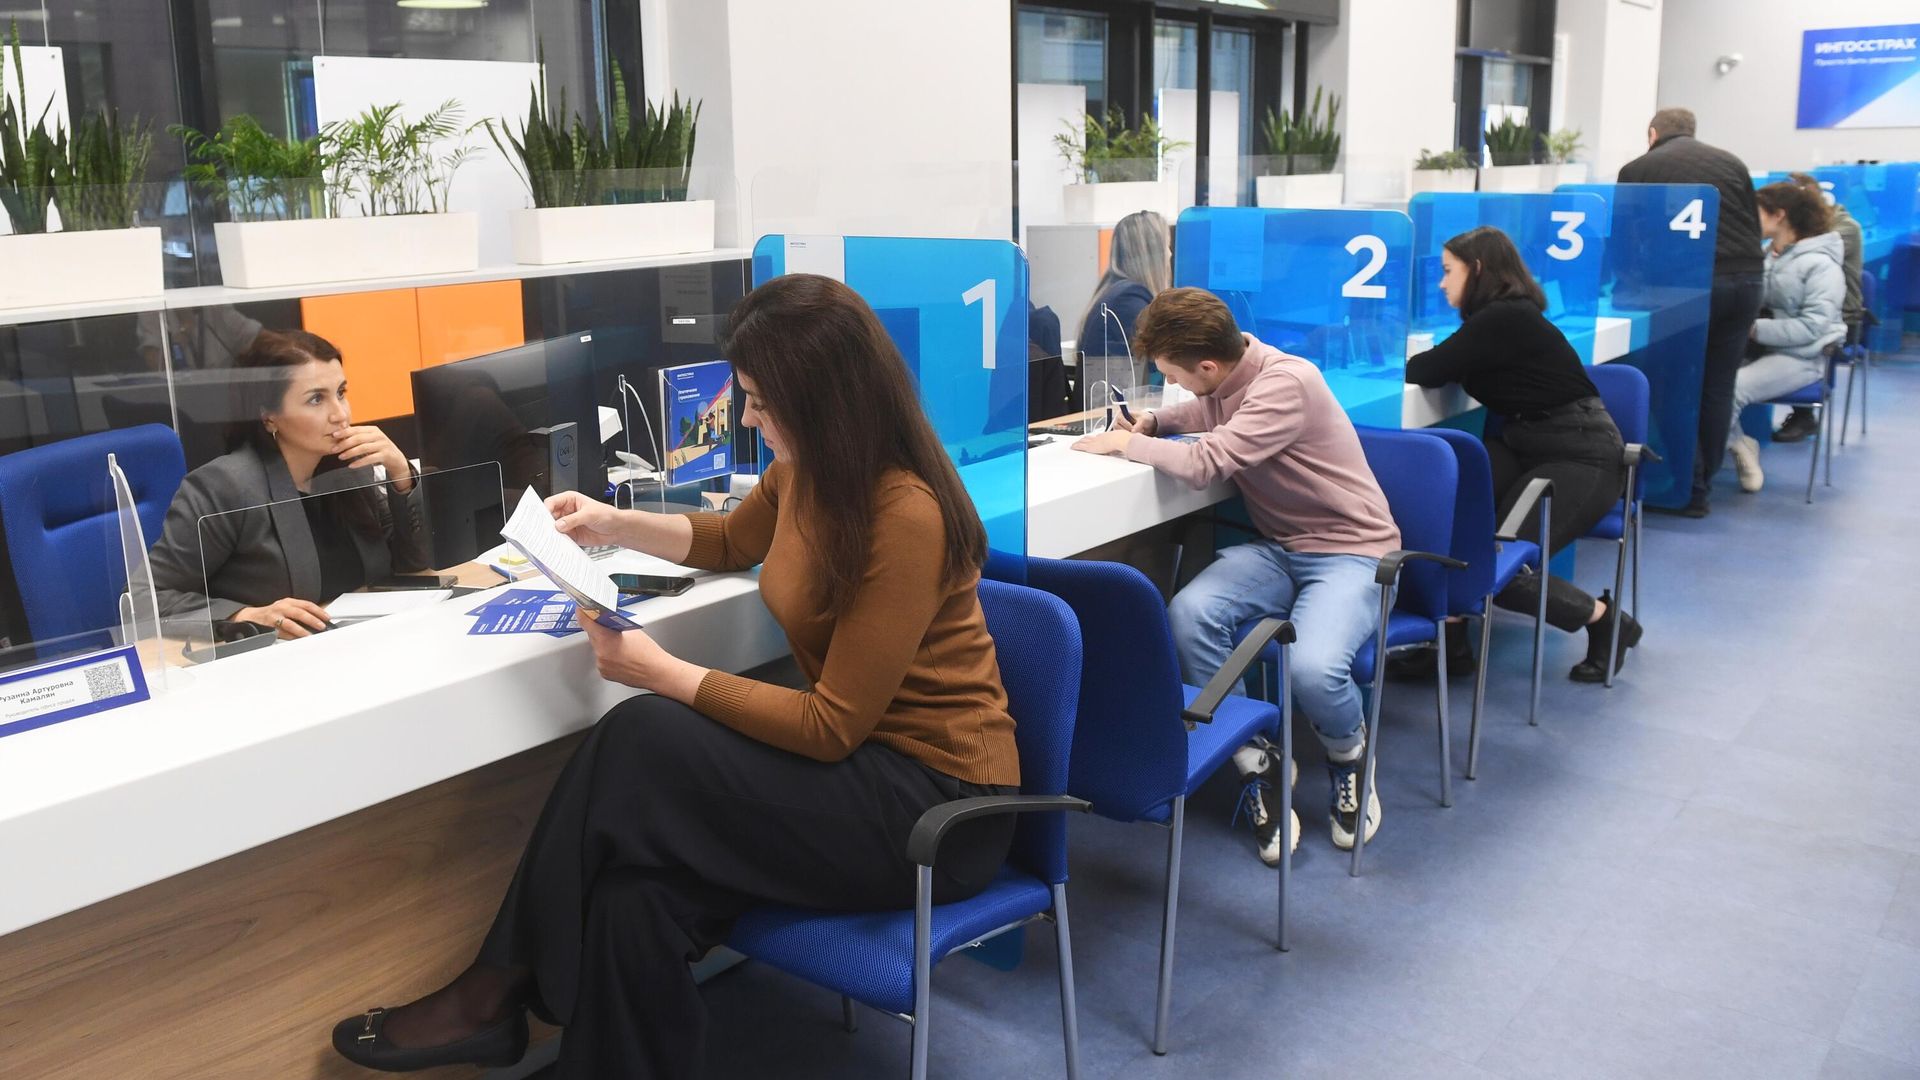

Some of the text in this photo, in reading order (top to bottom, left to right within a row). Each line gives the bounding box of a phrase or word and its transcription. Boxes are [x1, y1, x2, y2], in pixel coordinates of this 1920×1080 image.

[1815, 38, 1916, 54] ИНГОССТРАХ
[1546, 211, 1586, 261] 3
[1669, 199, 1707, 239] 4
[1341, 234, 1387, 299] 2
[962, 279, 996, 370] 1
[20, 692, 55, 704] Камалян
[32, 680, 74, 694] Артуровна
